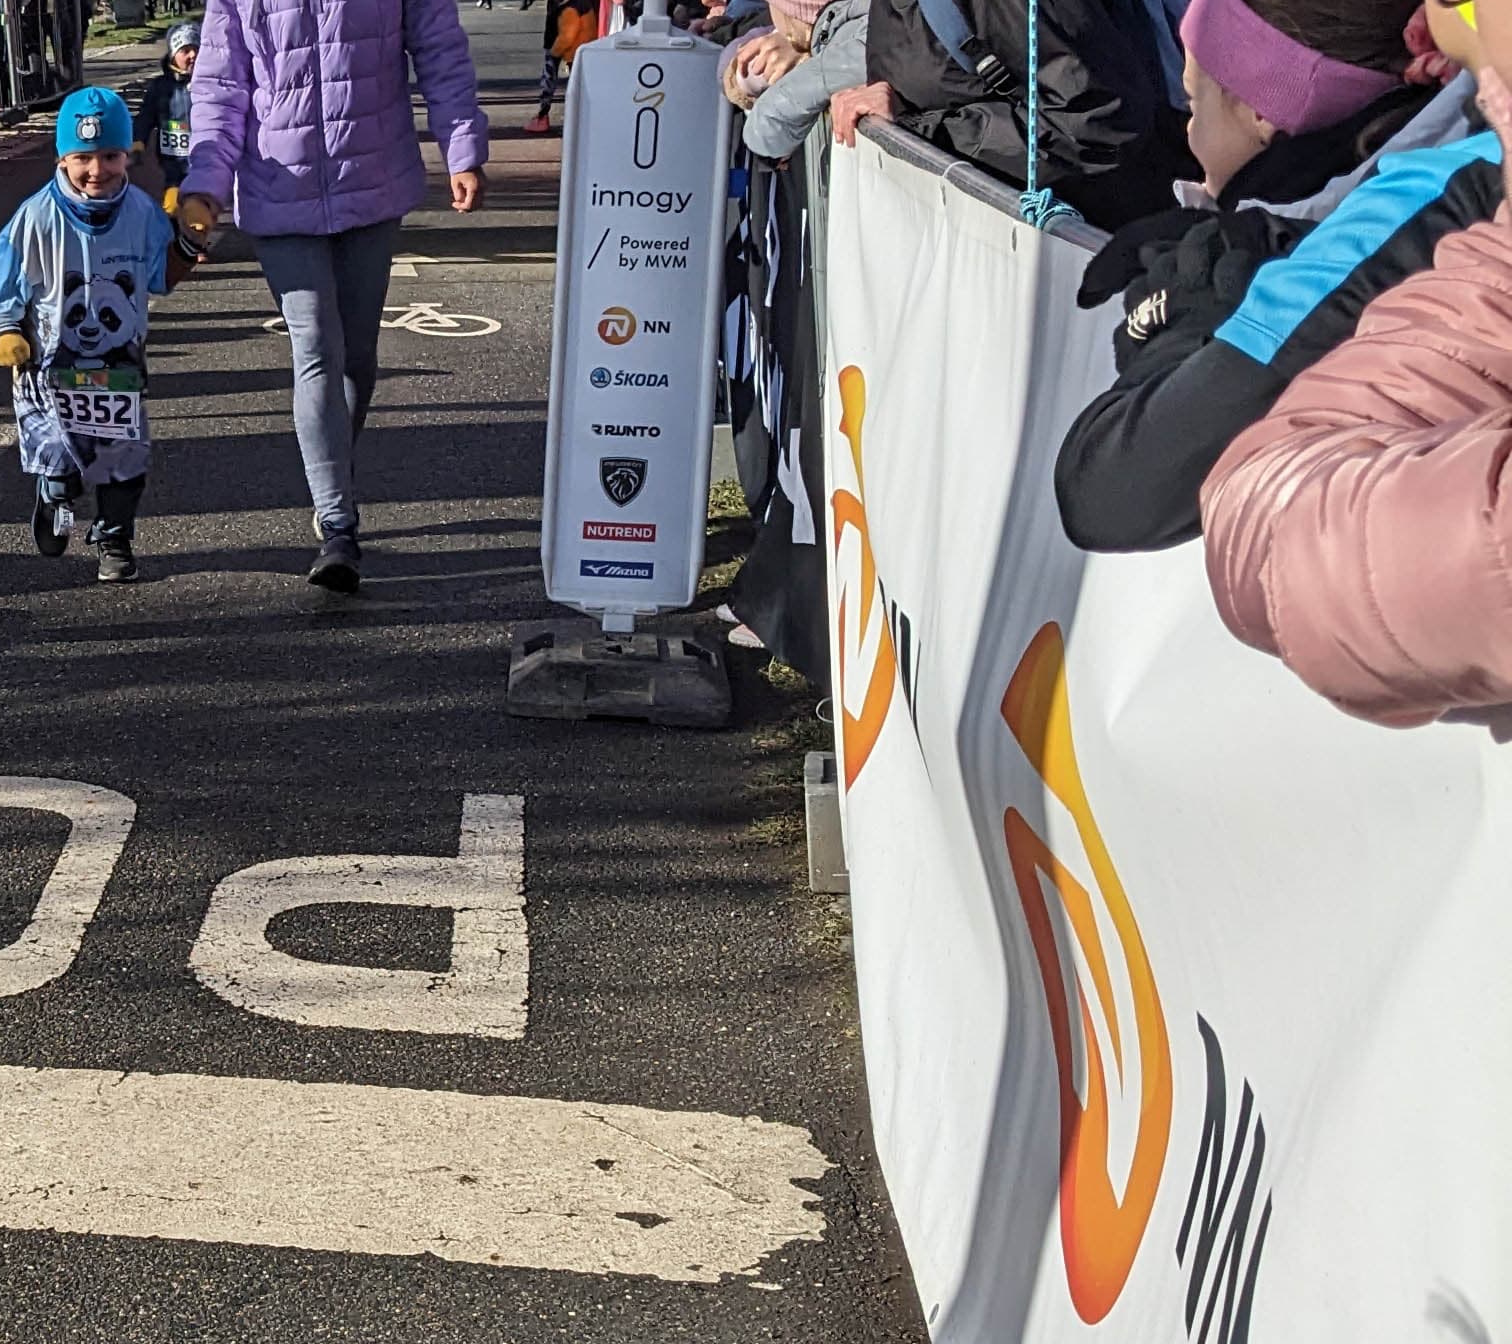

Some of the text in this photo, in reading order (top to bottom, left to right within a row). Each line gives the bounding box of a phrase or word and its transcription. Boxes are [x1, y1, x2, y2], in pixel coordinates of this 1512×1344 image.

[161, 132, 190, 149] 338
[592, 184, 693, 214] innogy
[620, 235, 690, 252] Powered
[619, 254, 687, 272] by MVM
[643, 320, 671, 334] NN
[613, 369, 670, 387] ŠKODA
[54, 392, 132, 425] 3352
[604, 425, 661, 438] RUNTO
[586, 524, 653, 539] NUTREND
